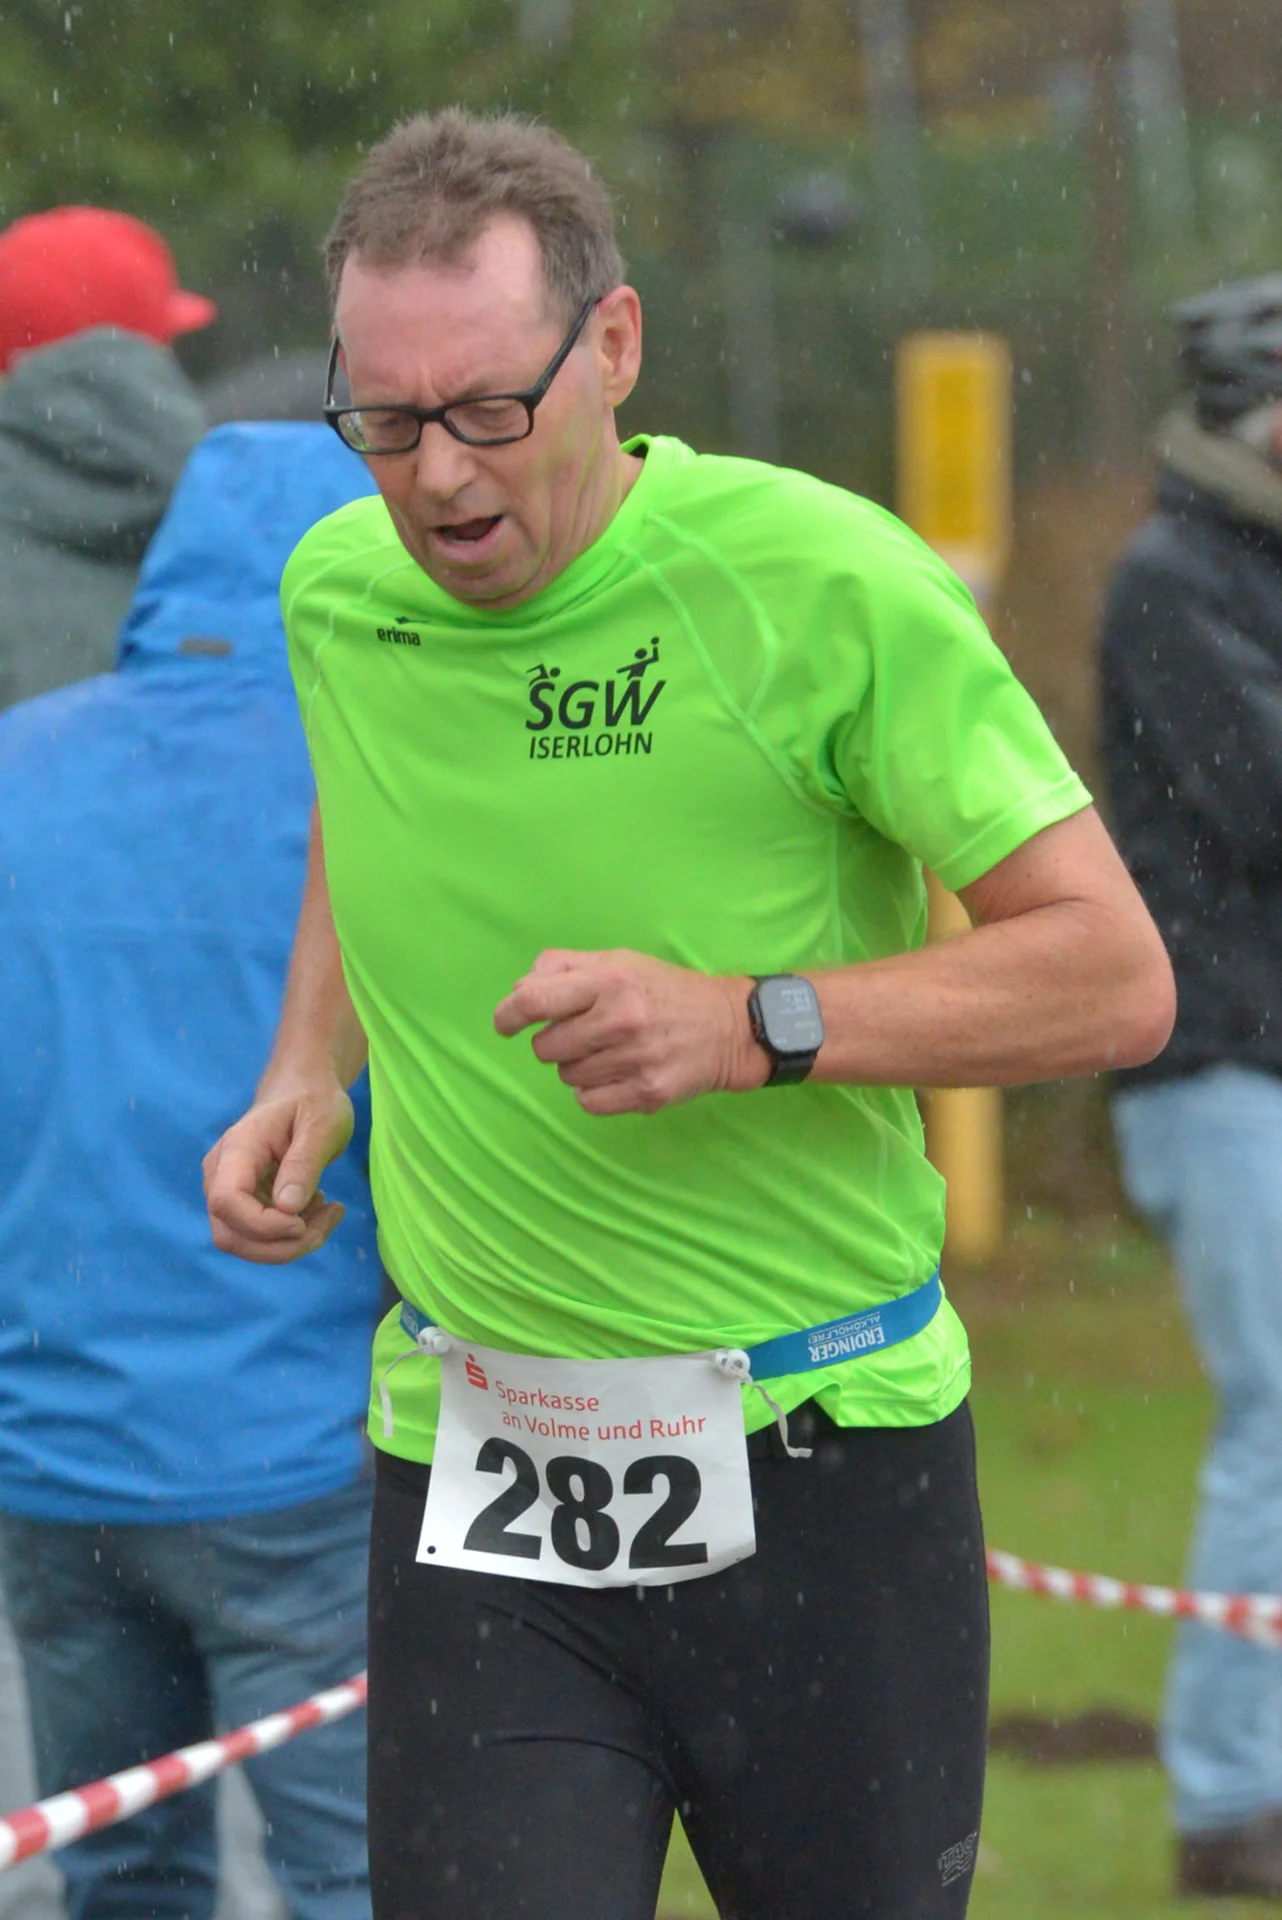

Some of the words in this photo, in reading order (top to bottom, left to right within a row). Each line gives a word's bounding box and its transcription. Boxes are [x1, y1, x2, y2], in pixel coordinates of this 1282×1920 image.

[377, 626, 421, 646] erima
[525, 679, 667, 731] SGW
[529, 732, 653, 760] ISERLOHN
[808, 1326, 886, 1363] ERDINGER
[495, 1381, 600, 1412] Sparkasse
[502, 1411, 522, 1429] an
[524, 1417, 590, 1441] Volme
[598, 1420, 642, 1441] und
[651, 1415, 706, 1439] Ruhr
[463, 1437, 709, 1571] 282
